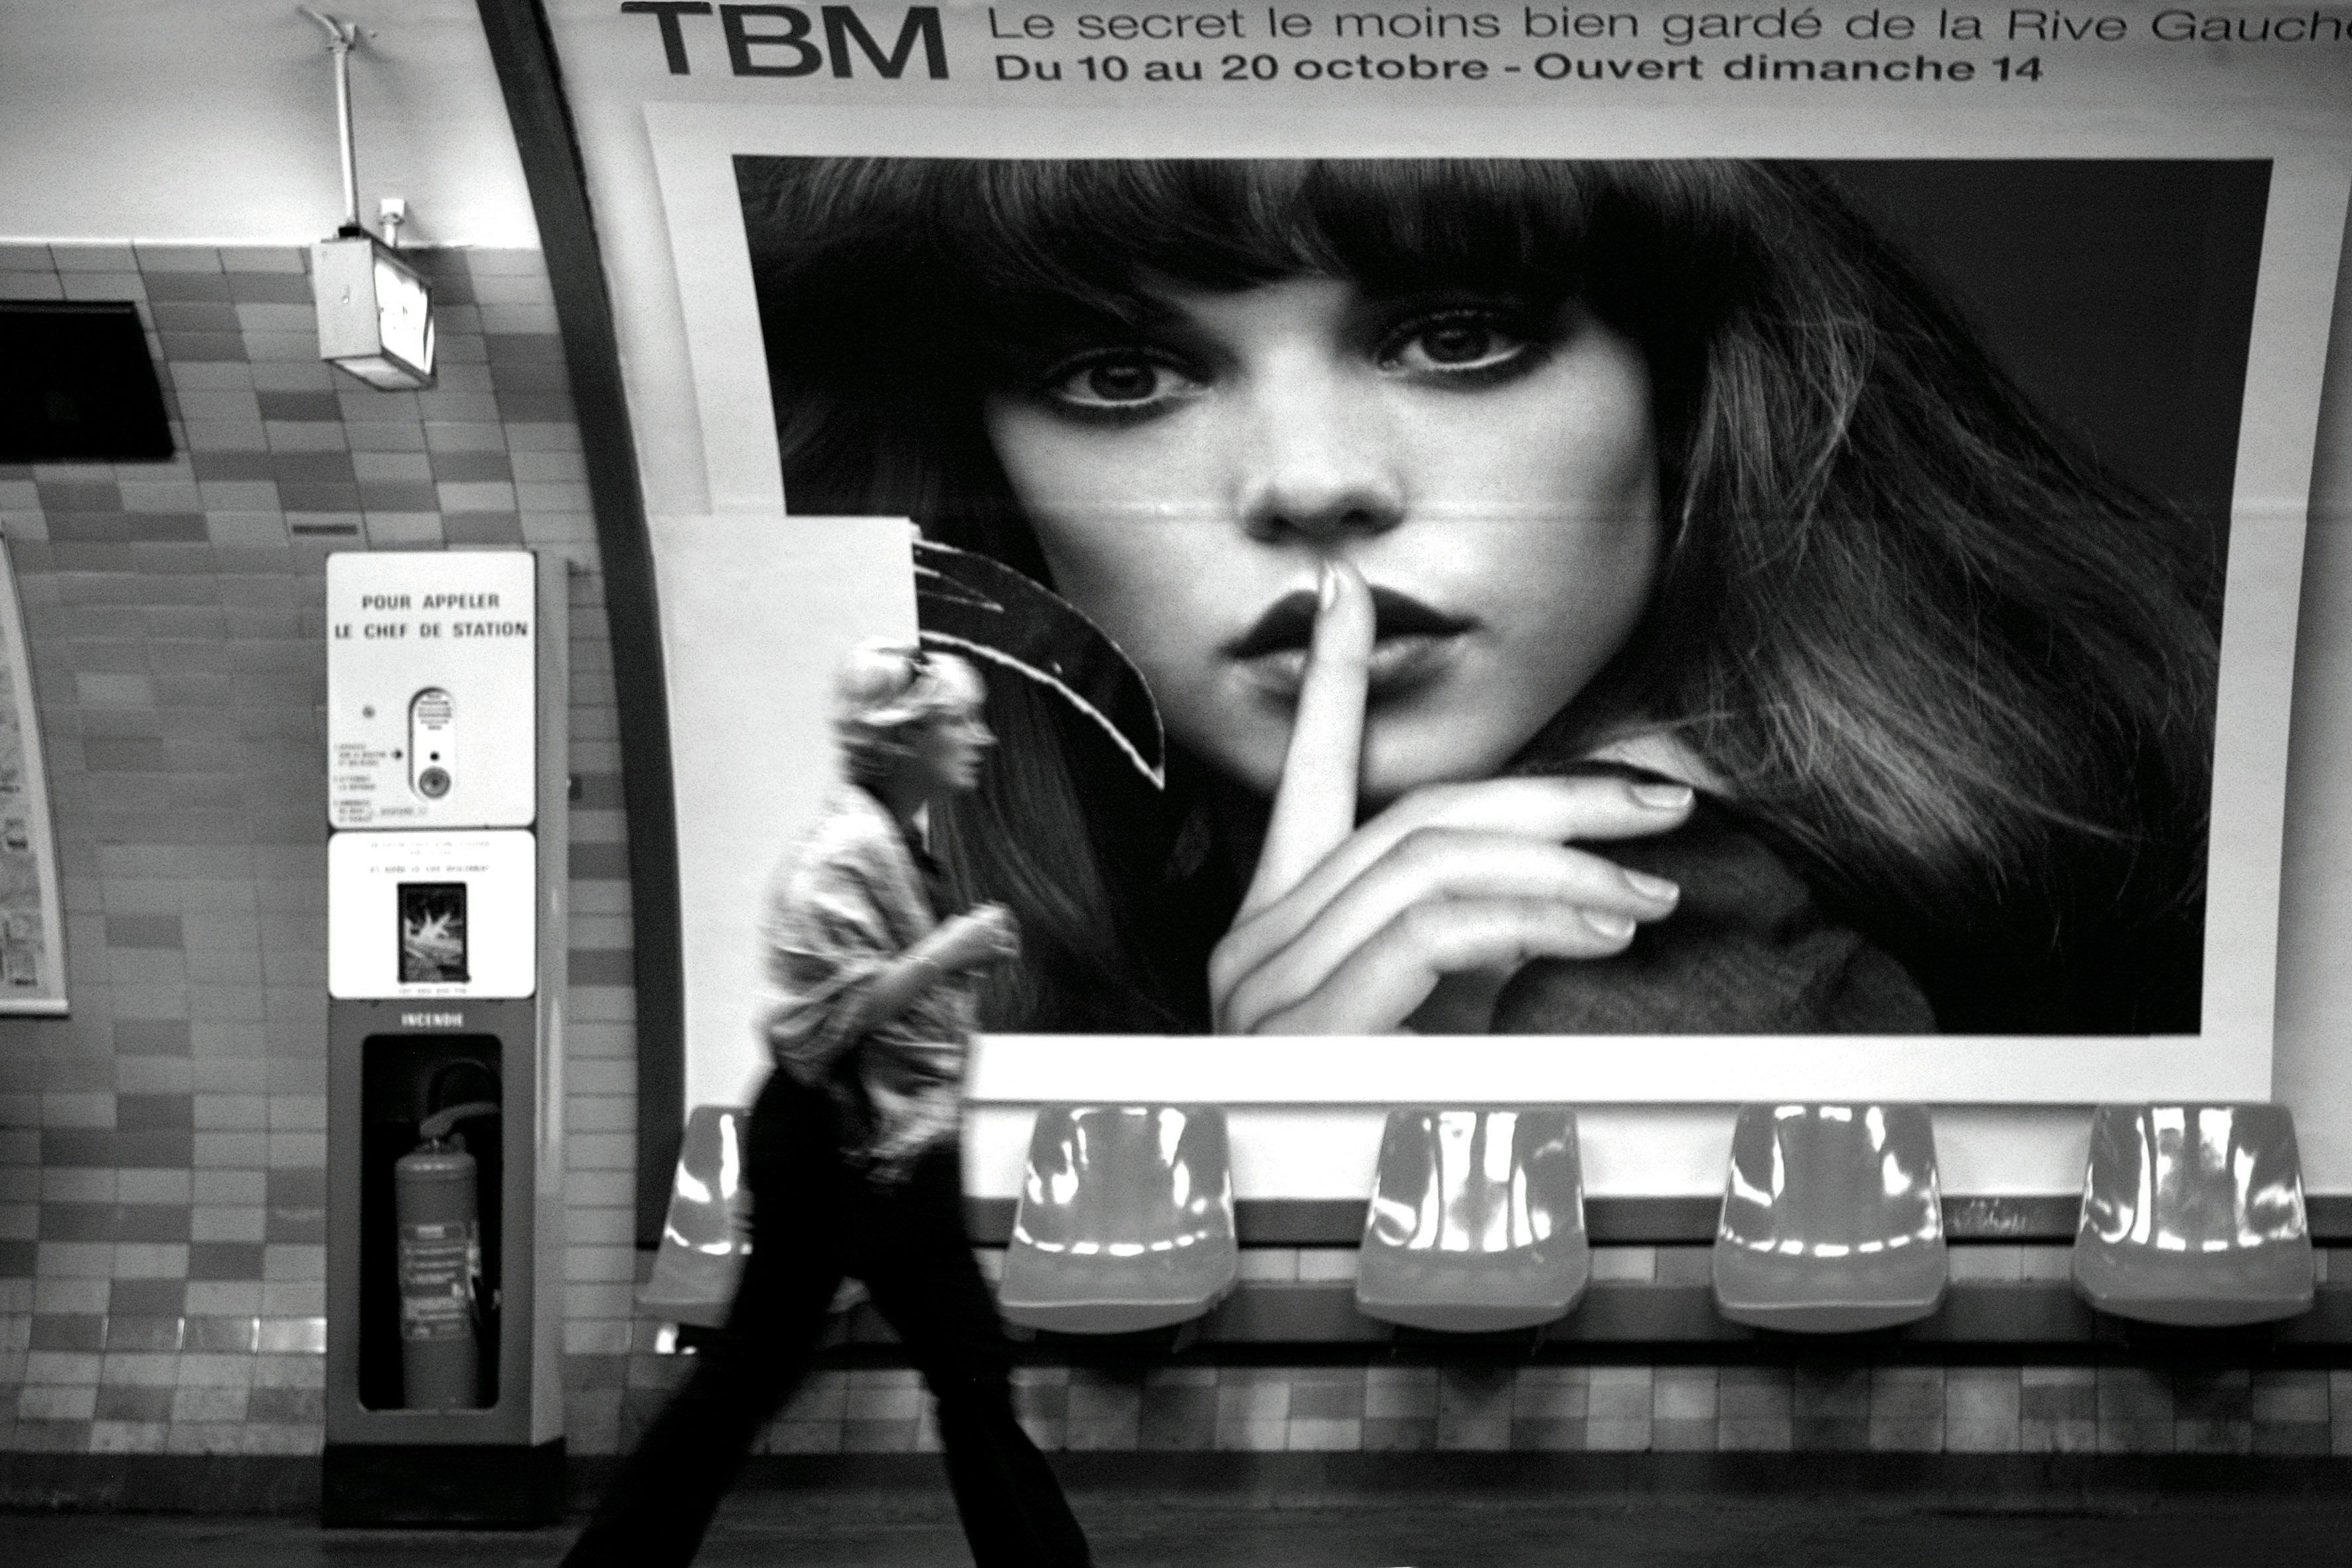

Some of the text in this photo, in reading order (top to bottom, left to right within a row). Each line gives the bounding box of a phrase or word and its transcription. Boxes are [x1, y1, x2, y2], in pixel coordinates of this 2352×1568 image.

[988, 5, 2352, 46] Le secret le moins bien gardé de la Rive Gauch
[621, 1, 949, 80] TBM
[994, 54, 1062, 81] Du
[1077, 55, 1129, 82] 10
[1144, 60, 1202, 82] au
[1221, 54, 1279, 81] 20
[1294, 53, 1489, 80] octobre
[1533, 53, 1703, 81] Ouvert
[1723, 54, 1975, 82] dimanche
[1992, 56, 2043, 82] 14
[362, 593, 500, 610] POUR APPELER
[334, 621, 528, 639] LE CHEF DE STATION
[401, 1012, 463, 1027] INCENDIE
